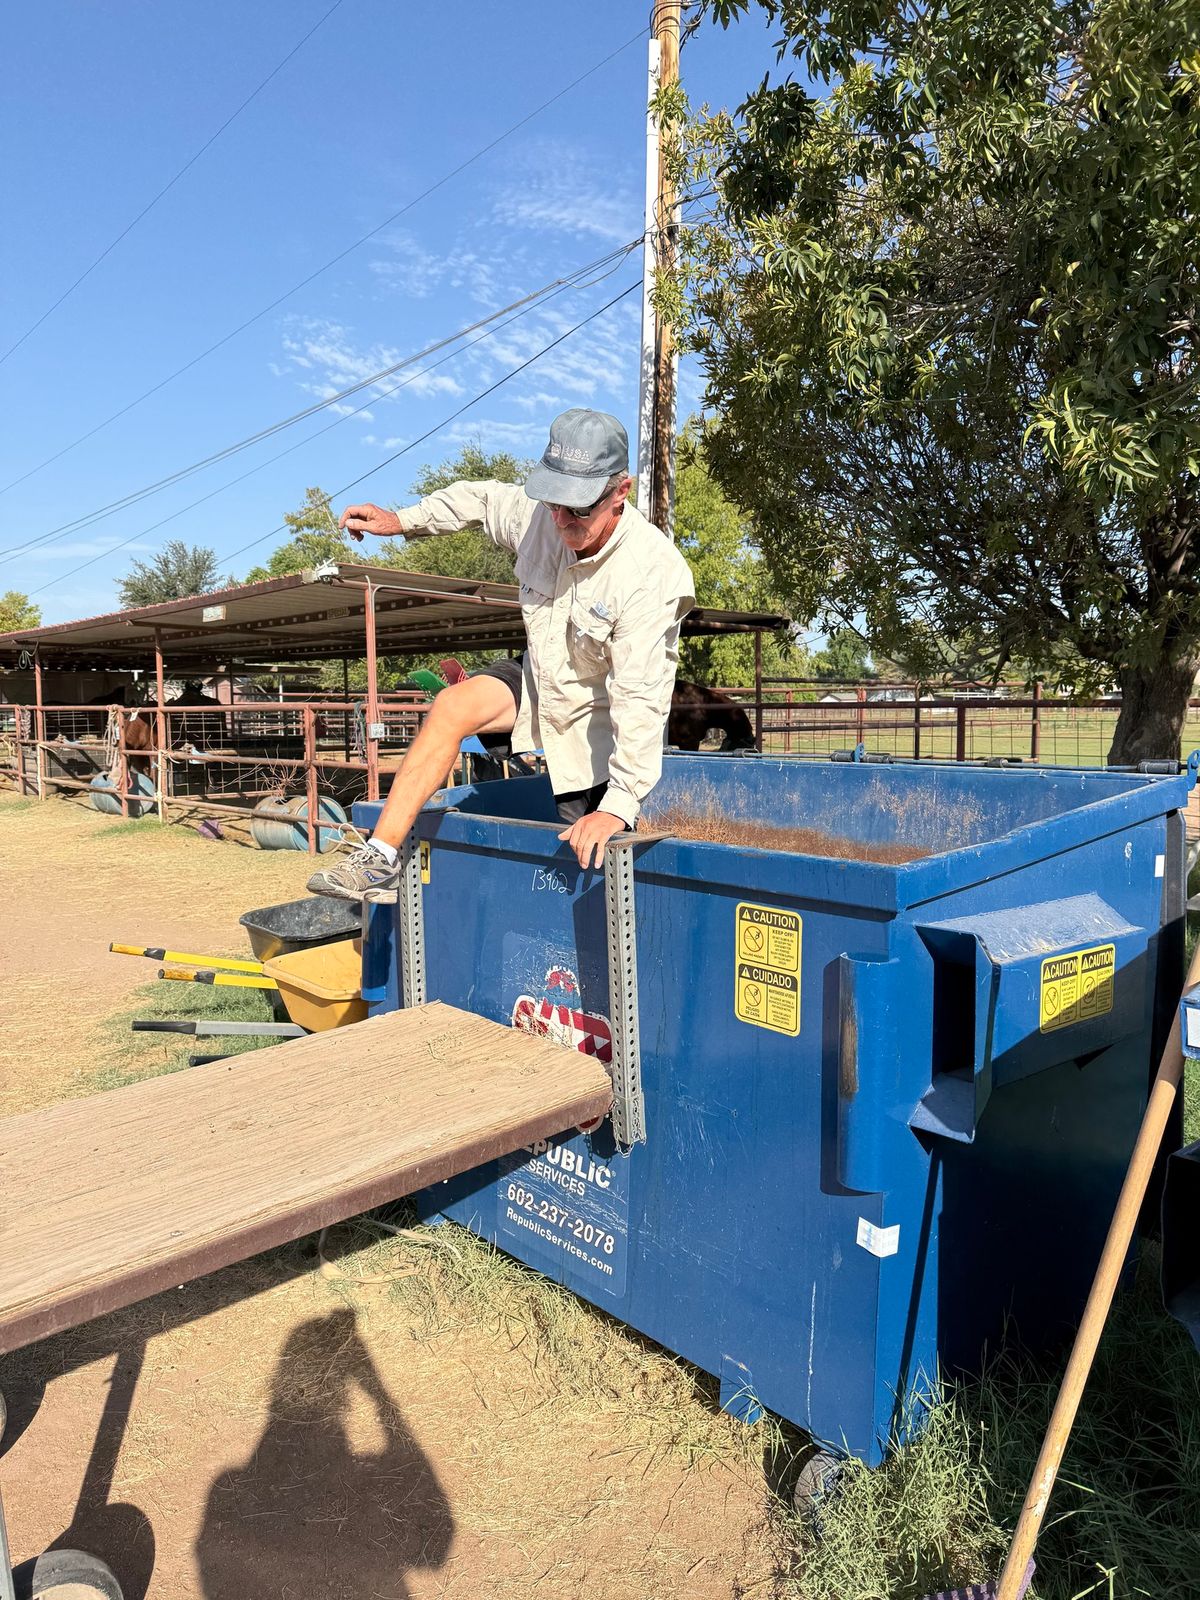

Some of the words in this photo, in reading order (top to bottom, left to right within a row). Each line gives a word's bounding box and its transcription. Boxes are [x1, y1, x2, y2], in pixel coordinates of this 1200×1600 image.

[565, 446, 591, 461] USA
[531, 869, 573, 893] 13902
[752, 910, 796, 929] CAUTION
[1050, 958, 1078, 978] CAUTION
[1088, 950, 1114, 969] CAUTION
[752, 968, 792, 989] CUIDADO
[528, 1158, 586, 1196] SERVICES
[507, 1183, 615, 1255] 602-237-2078
[506, 1206, 613, 1276] RepublicServices.com
